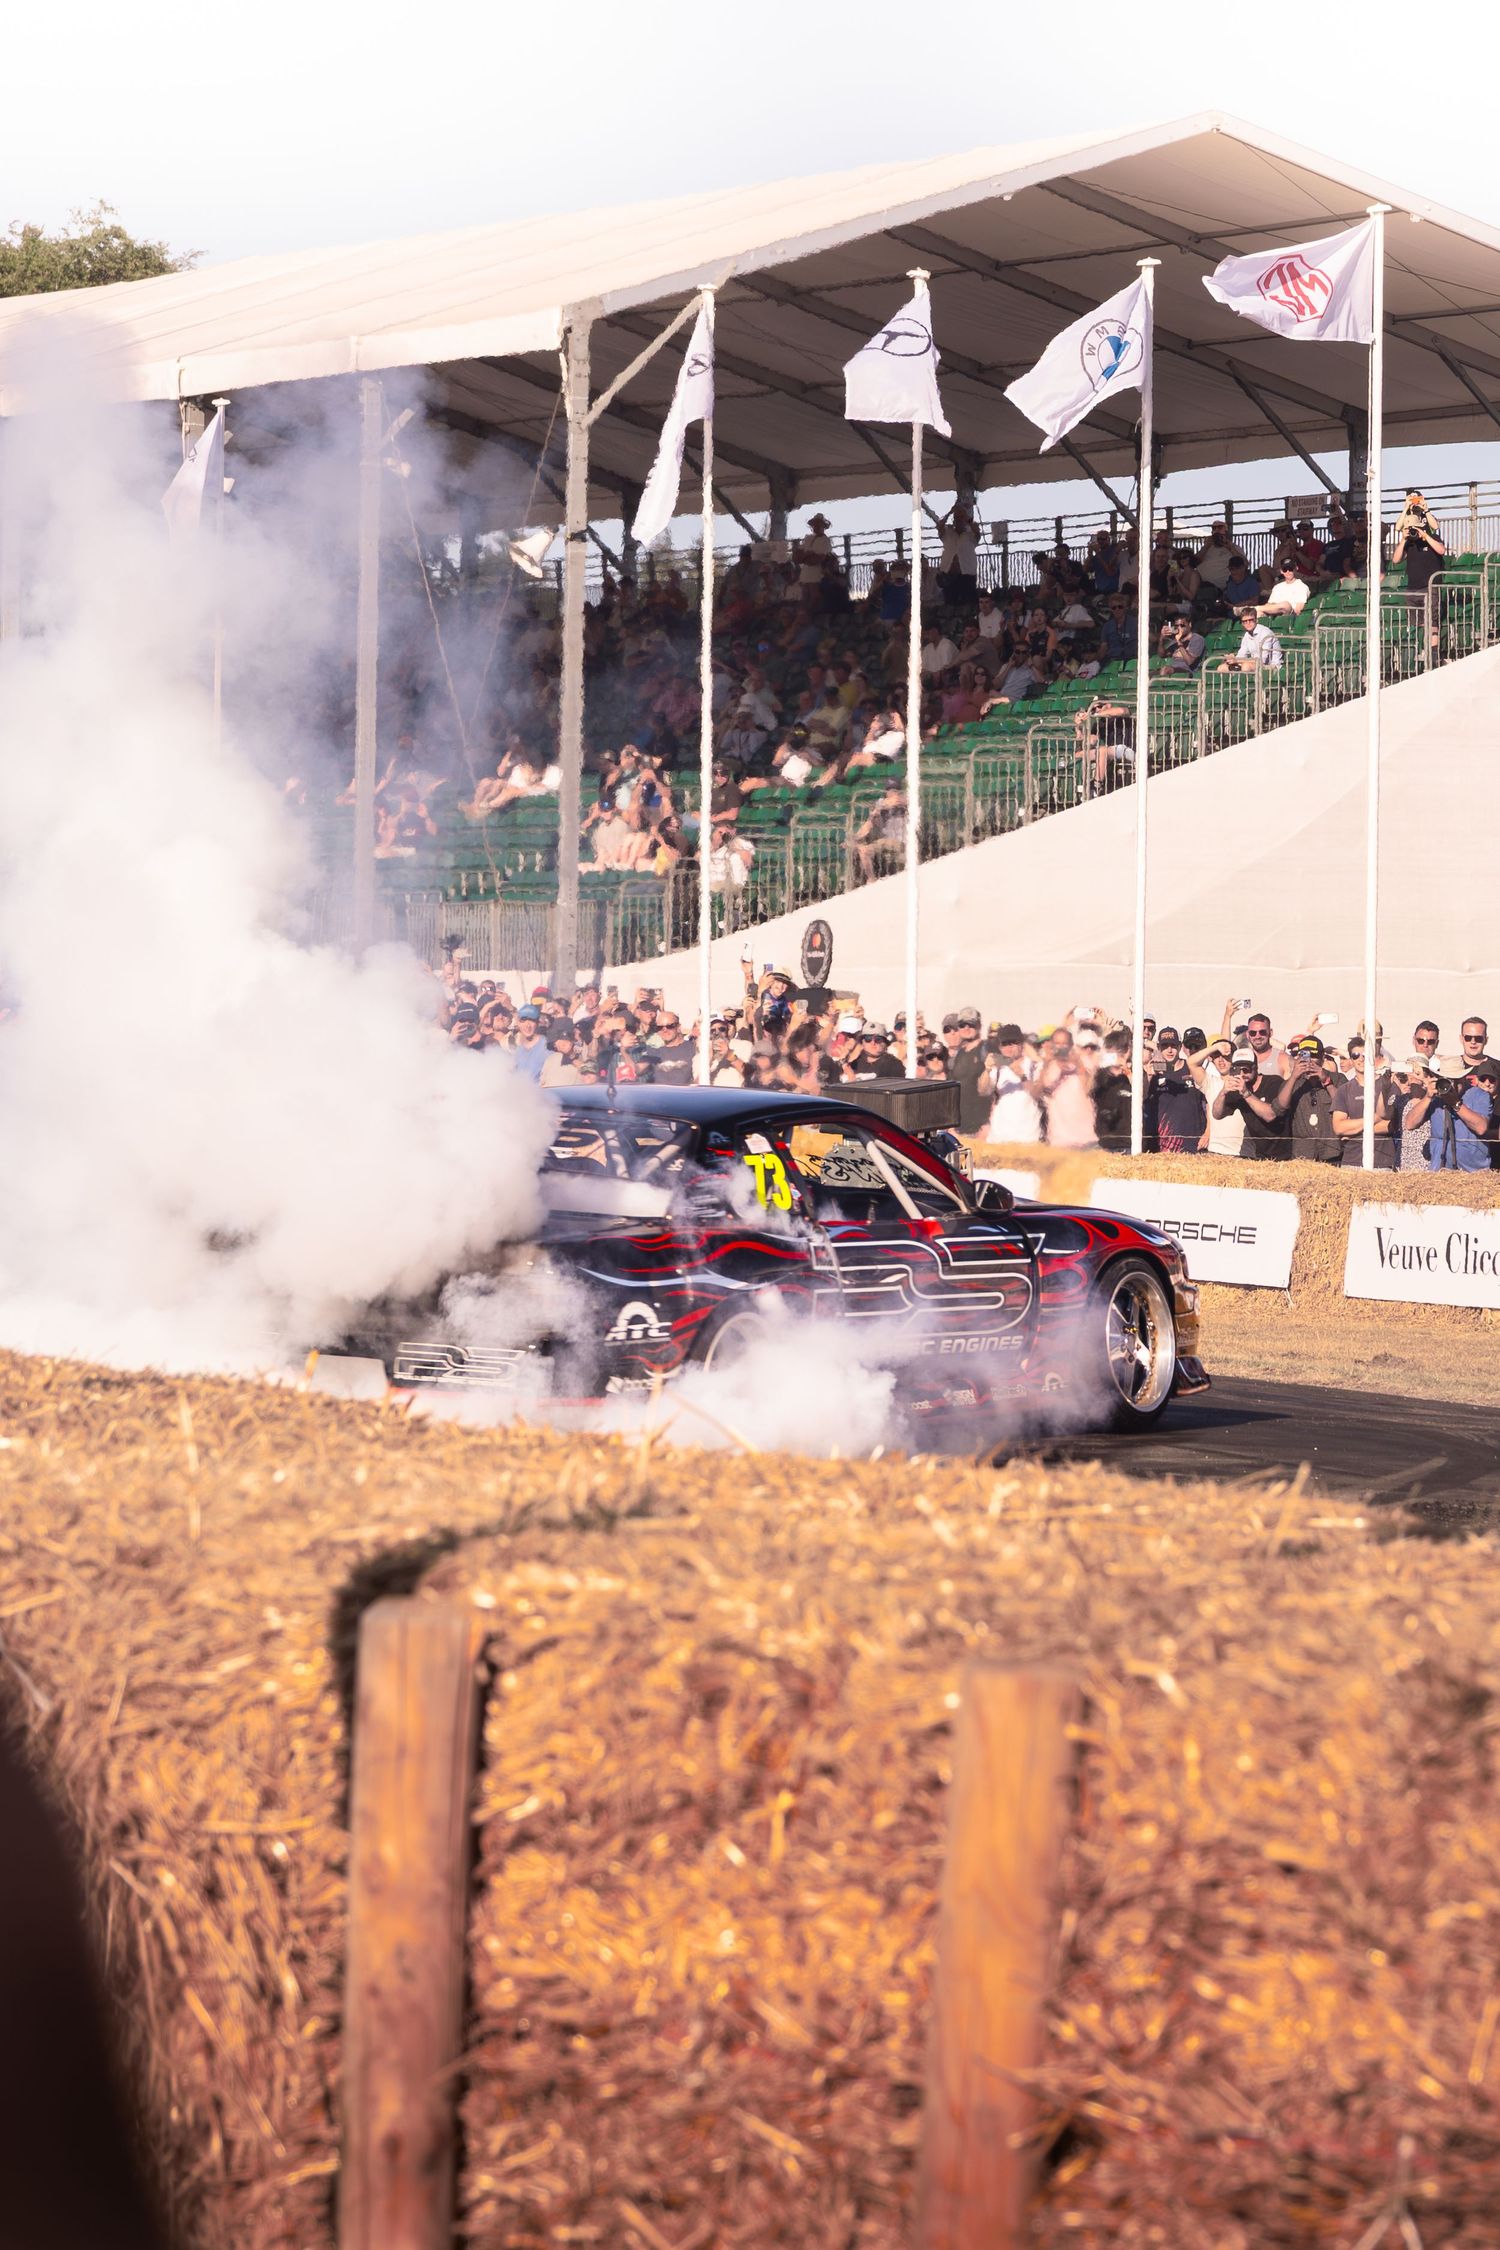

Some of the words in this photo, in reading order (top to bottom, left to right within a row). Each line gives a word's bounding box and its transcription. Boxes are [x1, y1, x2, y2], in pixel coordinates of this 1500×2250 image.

[743, 1153, 792, 1210] 73
[1374, 1226, 1438, 1272] Veuve
[939, 1335, 1024, 1354] ENGINES
